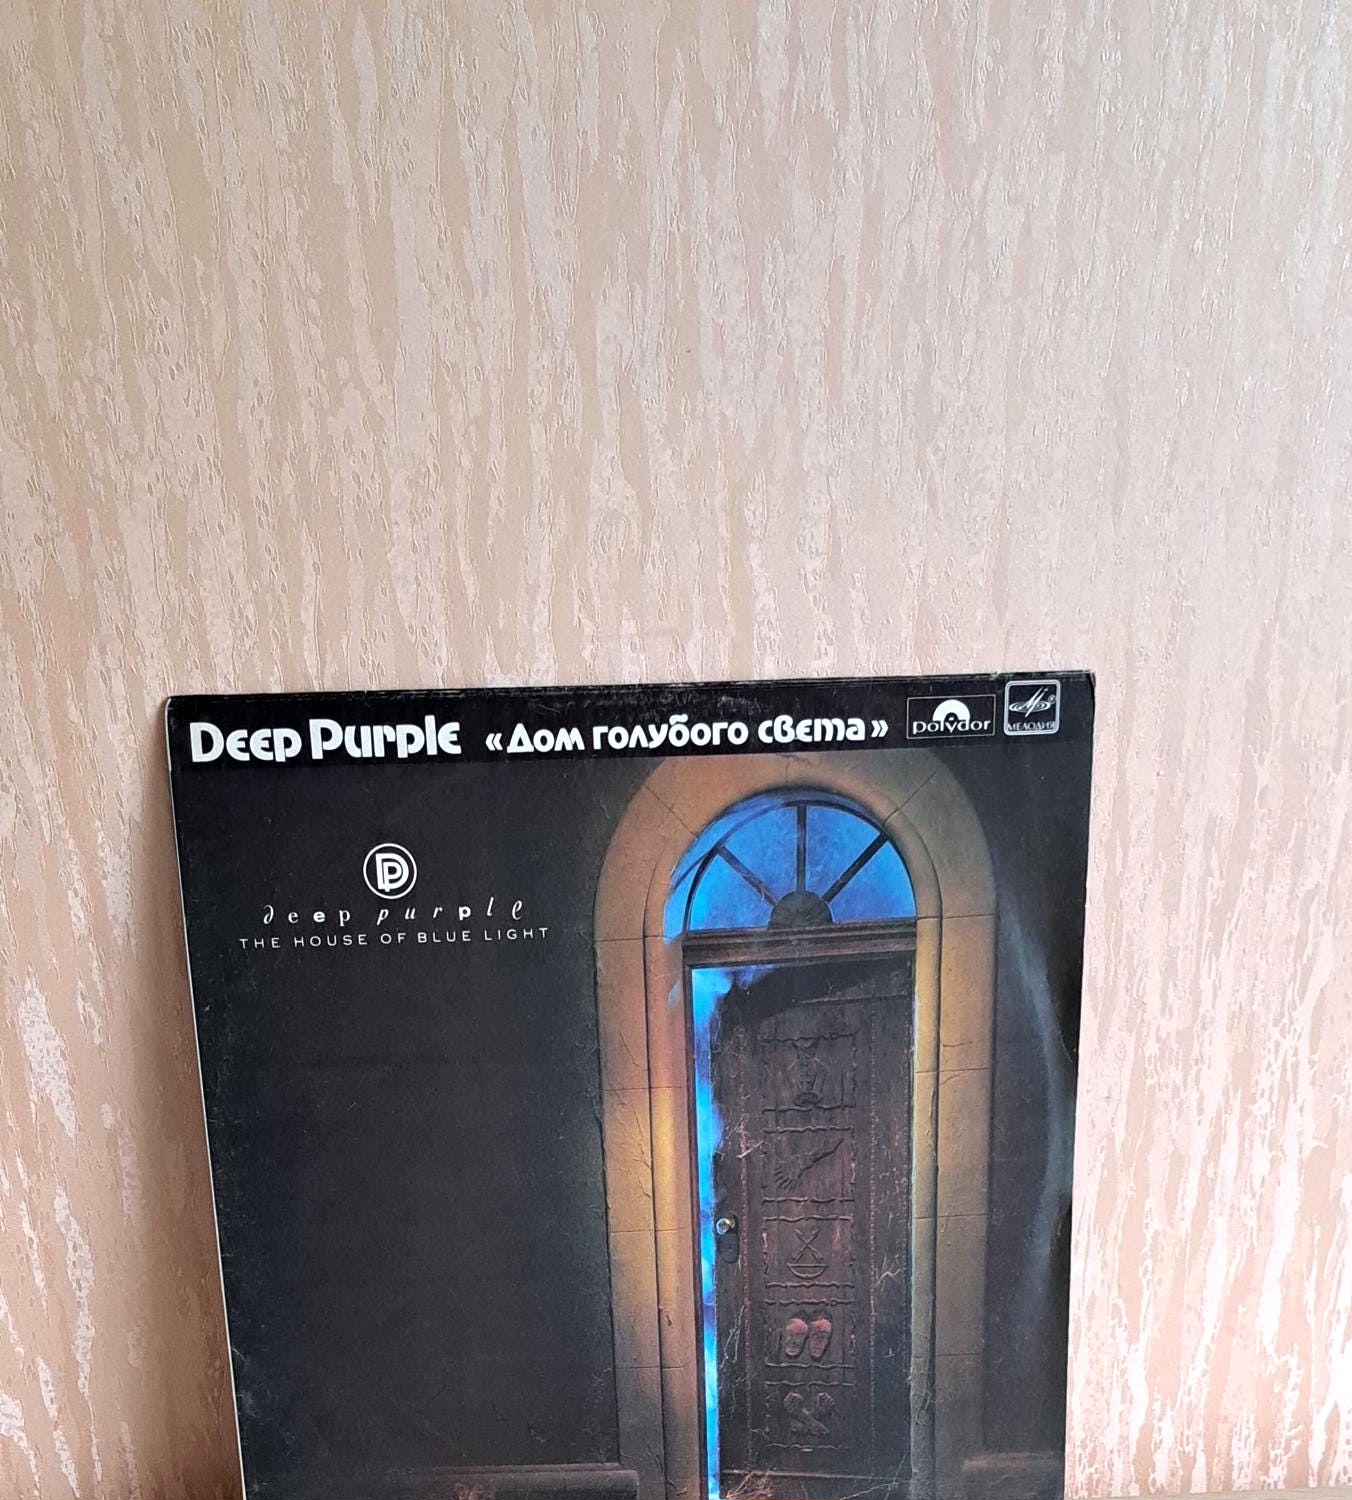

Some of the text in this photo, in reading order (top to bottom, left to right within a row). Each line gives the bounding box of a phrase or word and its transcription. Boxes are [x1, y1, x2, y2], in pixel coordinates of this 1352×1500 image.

[189, 714, 462, 763] Deep Purple
[593, 713, 749, 750] голубого
[262, 896, 524, 926] deep purple
[239, 926, 549, 950] THE HOUSE OF BLUE LIGHT
